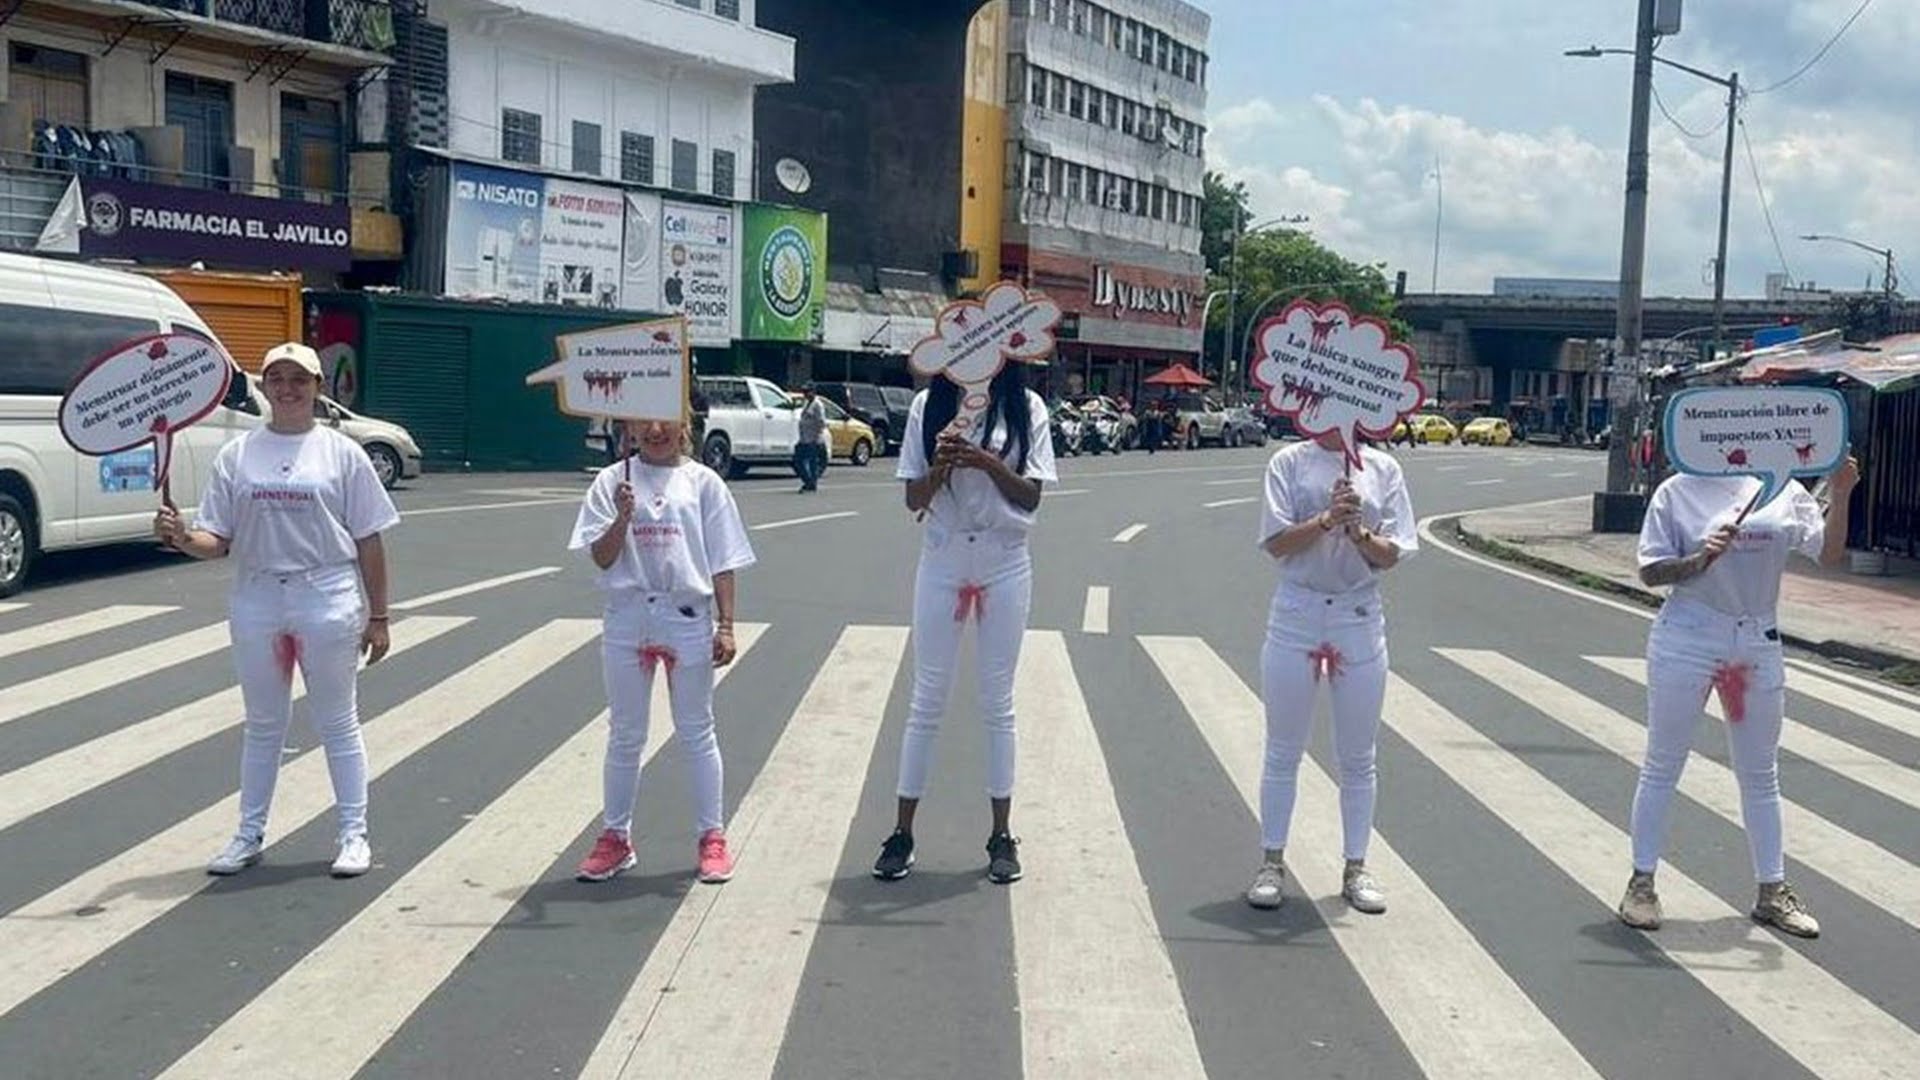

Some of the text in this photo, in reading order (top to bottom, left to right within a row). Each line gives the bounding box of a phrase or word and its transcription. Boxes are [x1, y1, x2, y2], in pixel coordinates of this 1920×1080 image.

[477, 183, 538, 208] NISATO
[130, 207, 243, 237] FARMACIA
[246, 221, 269, 239] EL
[272, 224, 348, 247] JAVILLO
[690, 280, 728, 297] Galaxy
[1093, 263, 1193, 325] Dynasty
[685, 301, 728, 317] HONOR
[578, 346, 593, 357] La
[1286, 332, 1306, 350] La
[1351, 357, 1400, 382] sangre
[75, 347, 209, 416] Menstruar dignamente
[1271, 348, 1299, 364] que
[1357, 377, 1405, 402] correr
[82, 362, 216, 430] debe ser un derecho no
[117, 388, 192, 431] un privilegio
[1318, 383, 1382, 414] Menstrual
[1683, 402, 1829, 420] Menstruación libre de
[1700, 430, 1772, 445] impuestos
